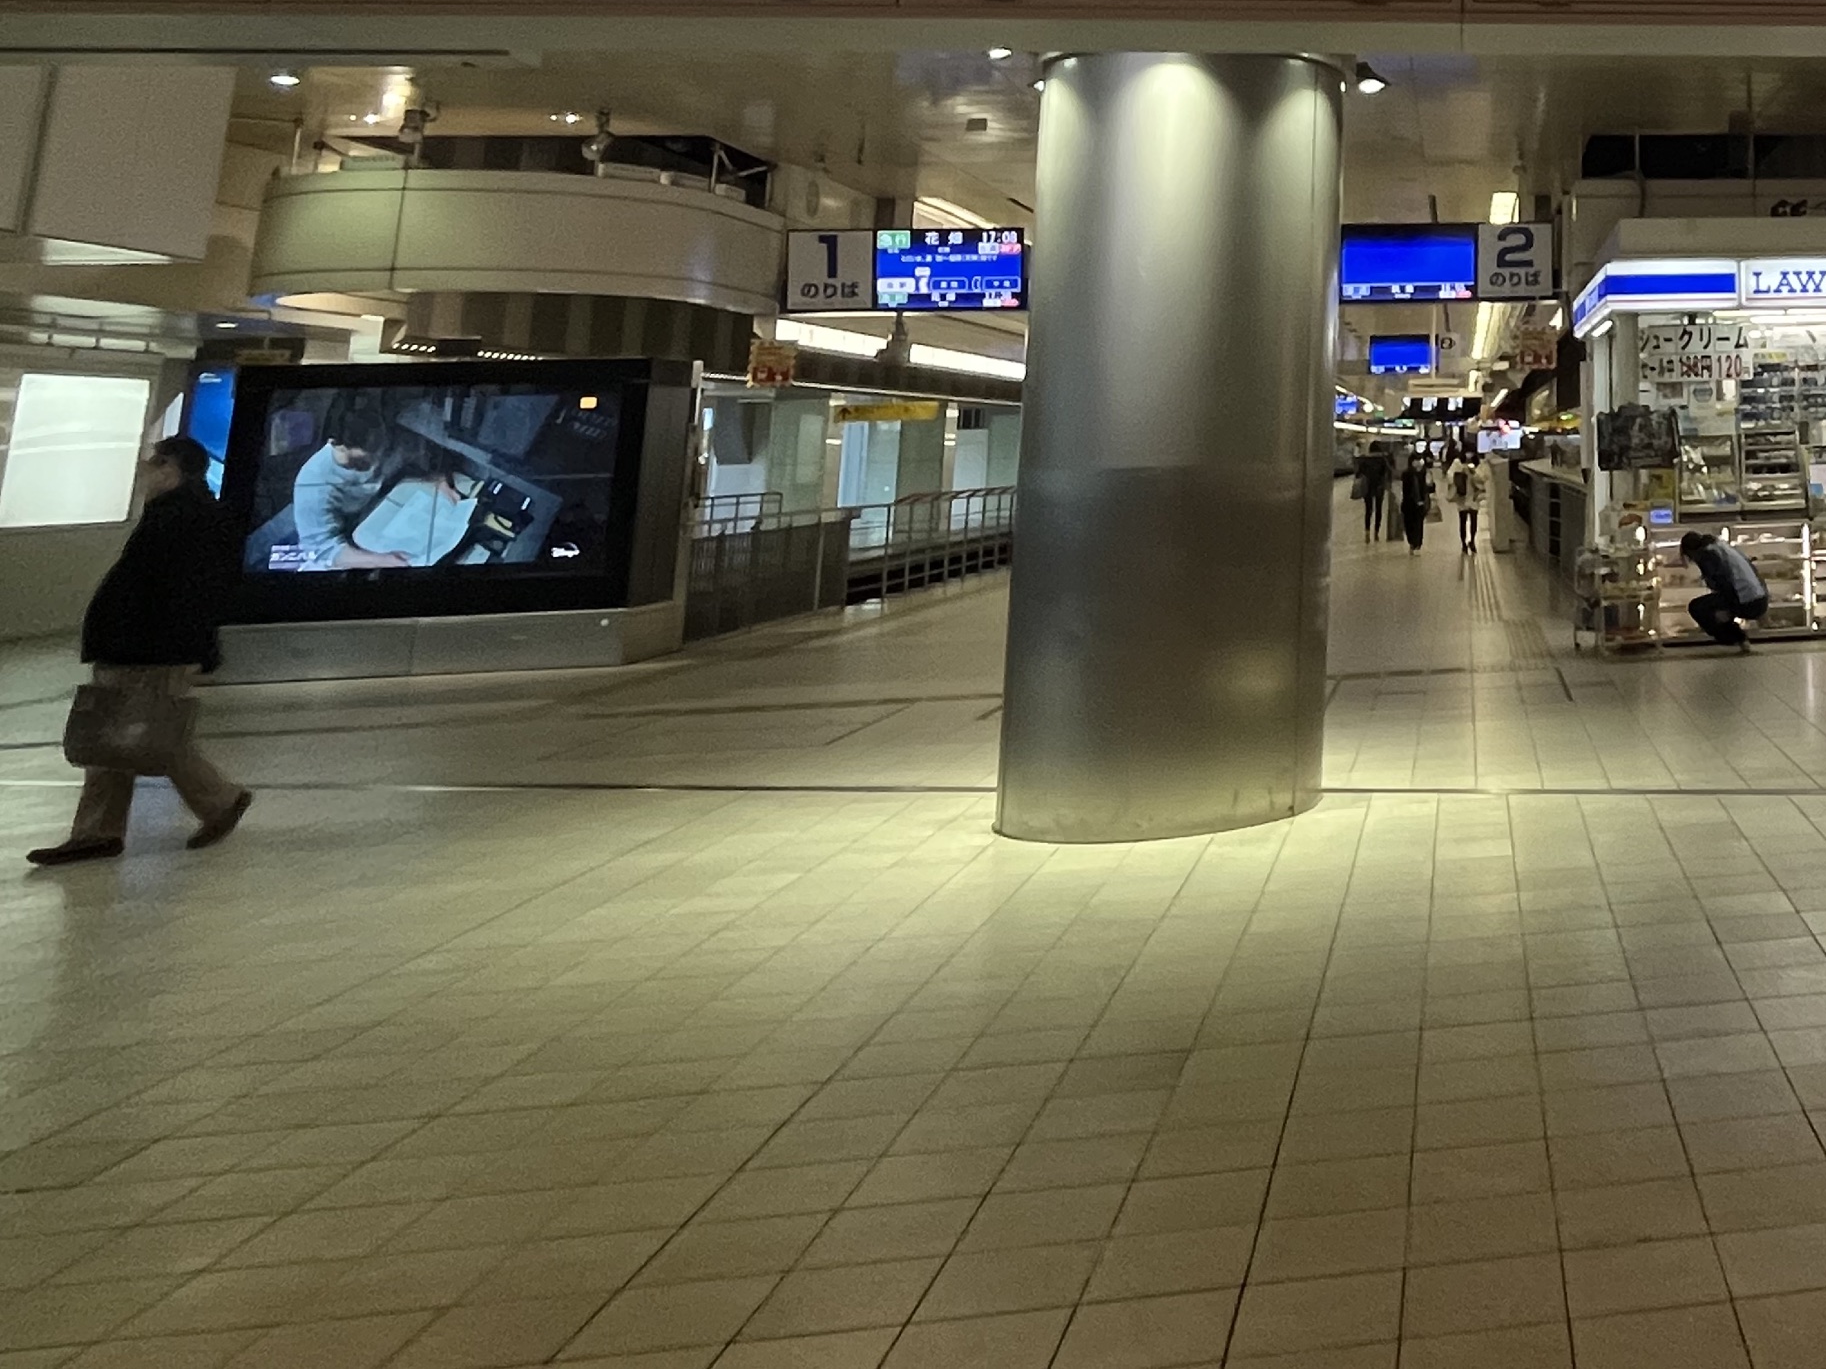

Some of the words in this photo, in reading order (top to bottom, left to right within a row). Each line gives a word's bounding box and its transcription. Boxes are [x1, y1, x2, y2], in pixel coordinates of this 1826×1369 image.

[818, 234, 839, 279] 1
[1496, 226, 1535, 269] 2
[800, 281, 859, 300] のりば
[1489, 271, 1542, 287] のりば
[1639, 327, 1749, 352] シュークリーム
